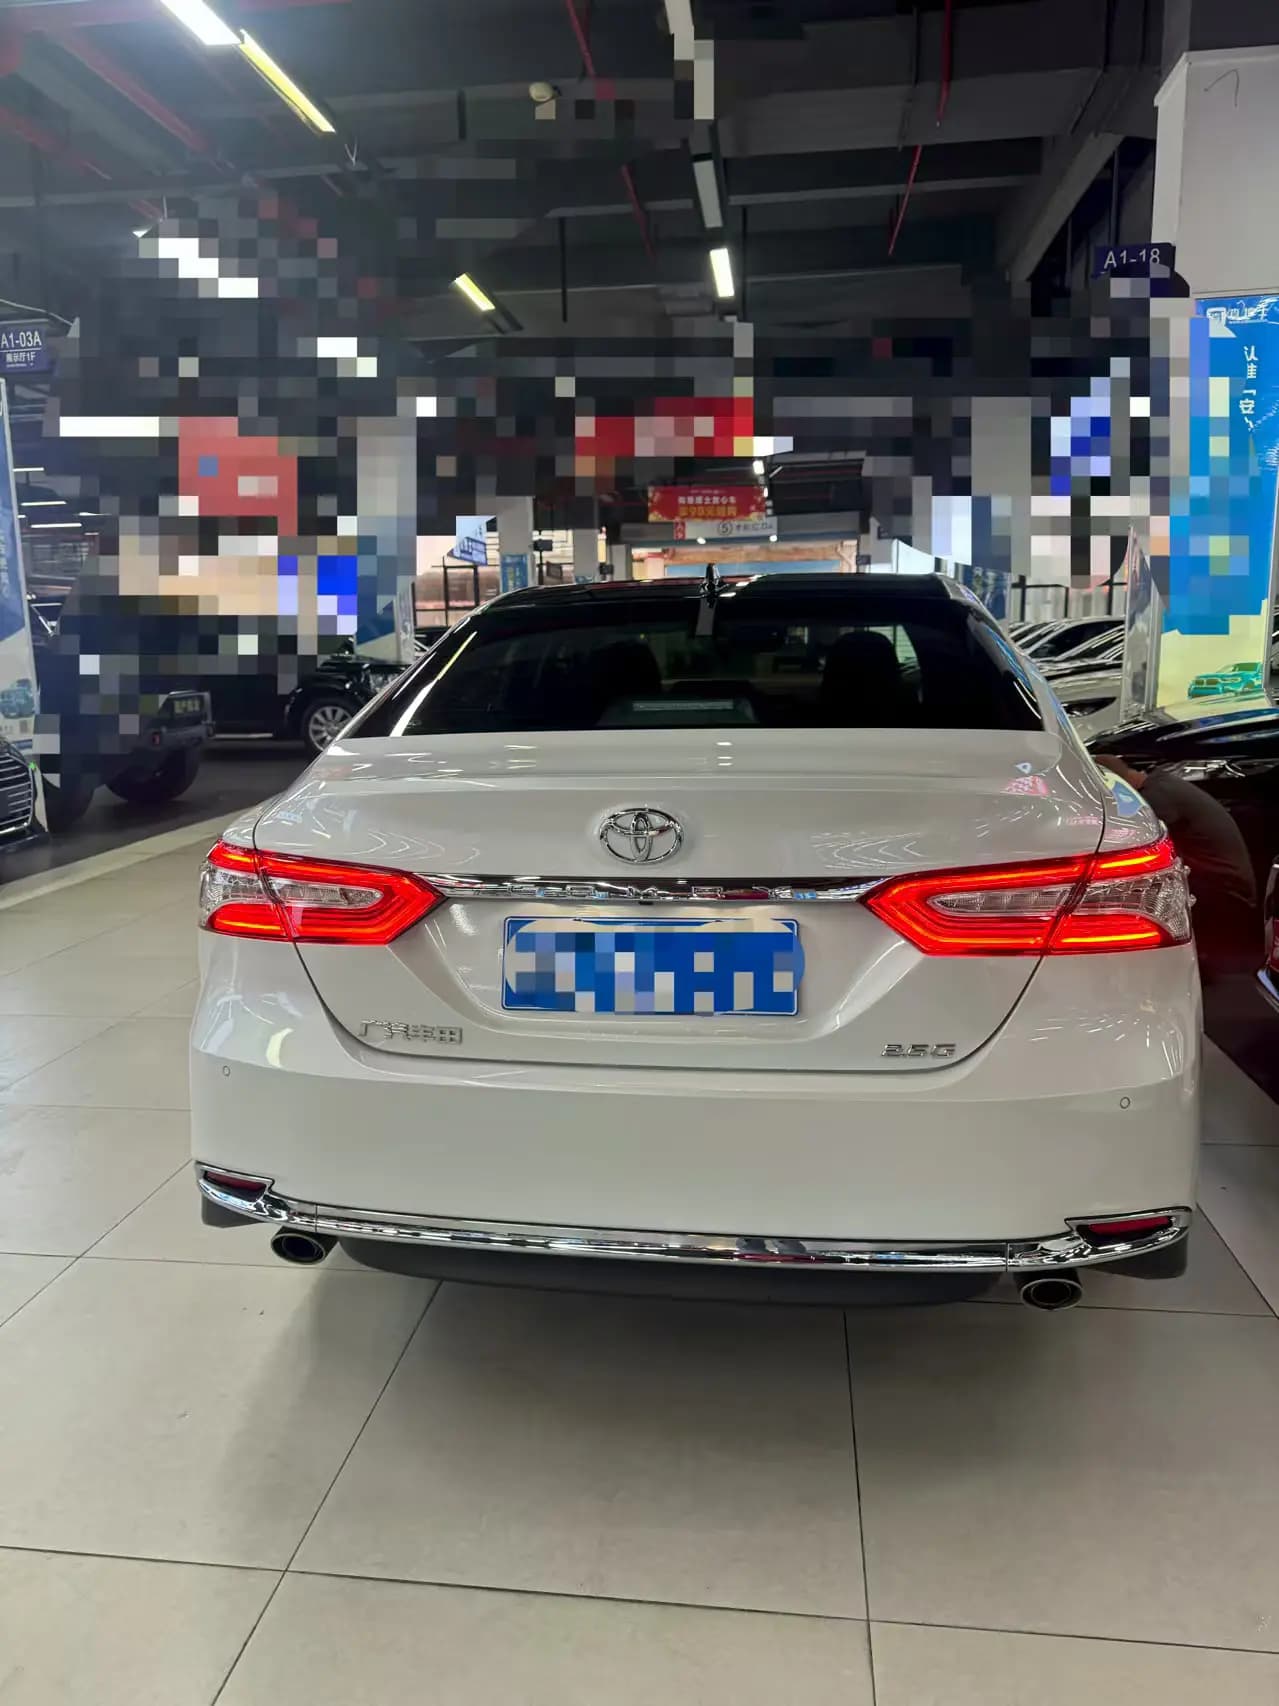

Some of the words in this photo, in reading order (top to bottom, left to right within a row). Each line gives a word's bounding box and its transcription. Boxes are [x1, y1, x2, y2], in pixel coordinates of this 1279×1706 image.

[1103, 248, 1160, 269] A1-18
[1, 331, 42, 348] A1-03A
[359, 1019, 463, 1044] 广汽丰田
